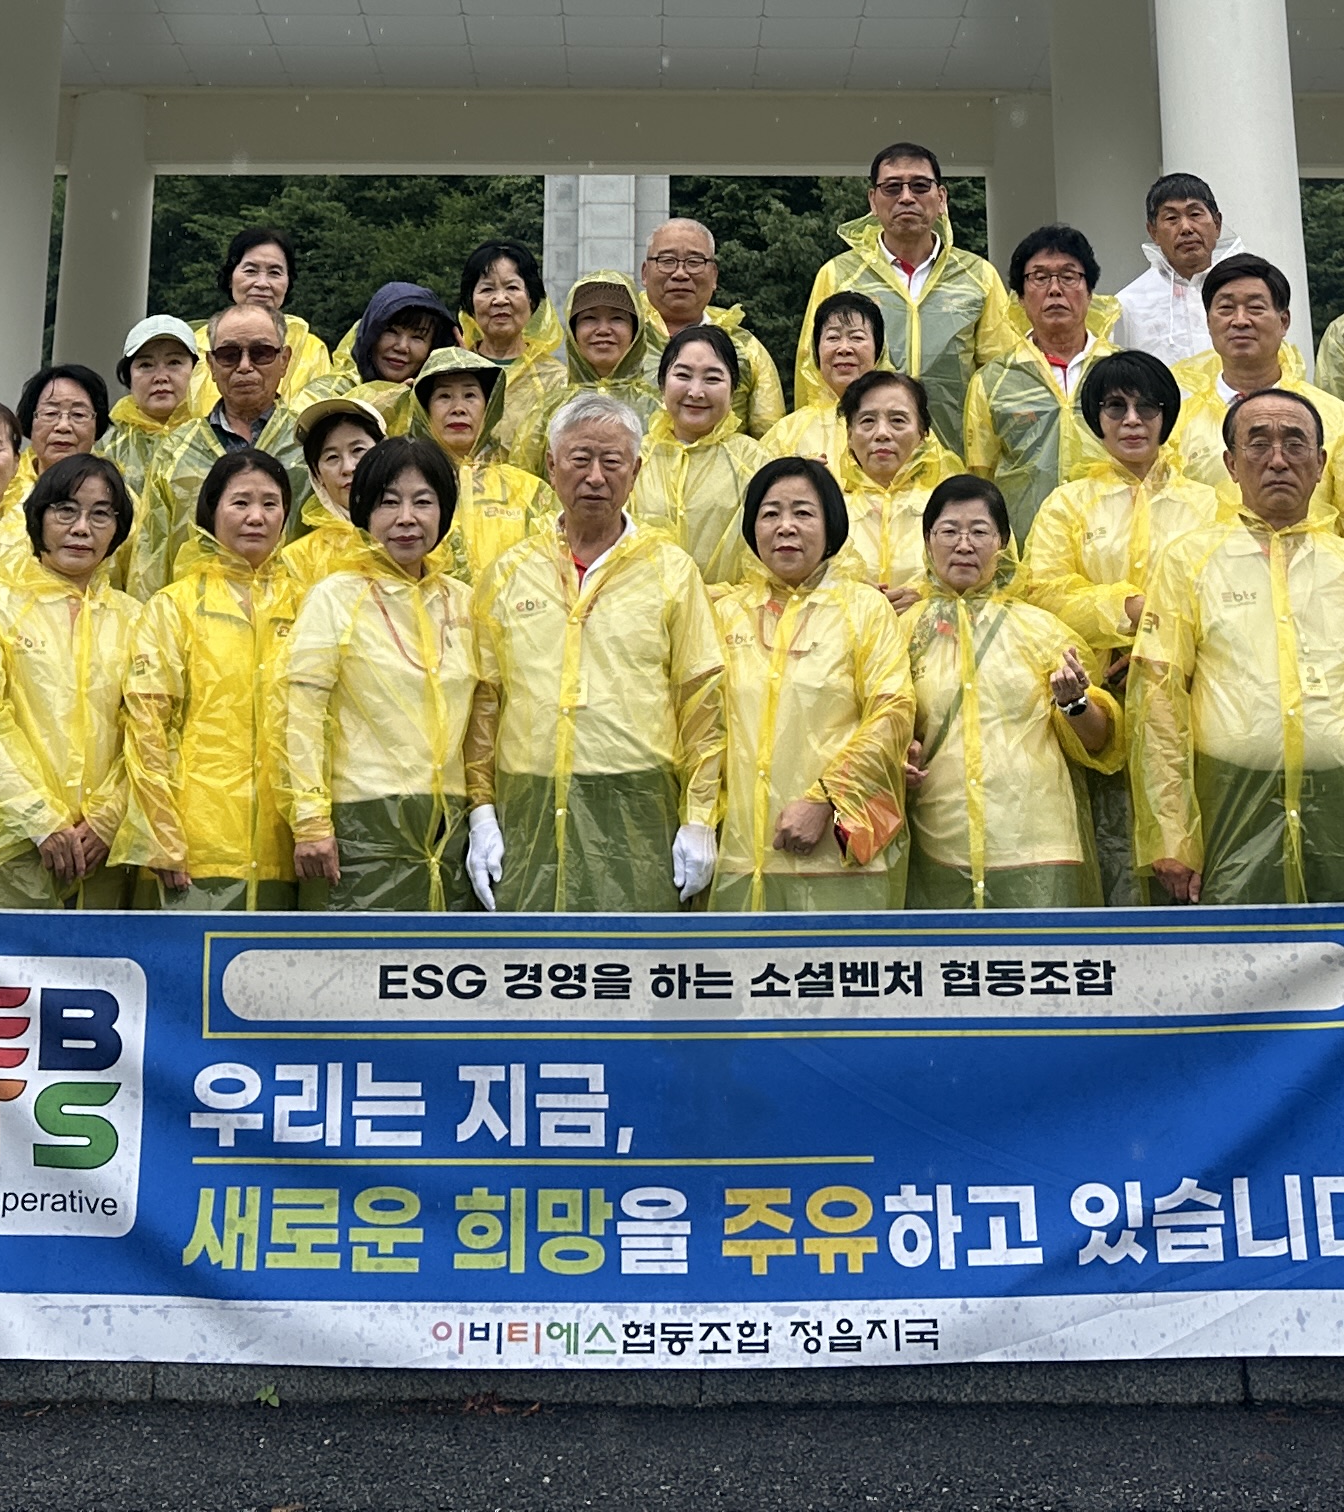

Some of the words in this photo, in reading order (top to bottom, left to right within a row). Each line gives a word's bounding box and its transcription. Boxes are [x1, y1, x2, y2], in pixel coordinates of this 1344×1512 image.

[378, 963, 488, 1000] ESG
[503, 963, 633, 1000] 경영을
[649, 962, 734, 1000] 하는
[750, 960, 924, 999] 소셜벤처
[939, 958, 1117, 997] 협동조합
[189, 1061, 426, 1149] 우리는
[455, 1062, 635, 1155] 지금,
[182, 1185, 424, 1274] 새로운
[453, 1185, 692, 1276] 희망을
[721, 1181, 1045, 1276] 주유하고
[789, 1316, 940, 1355] 정읍지국
